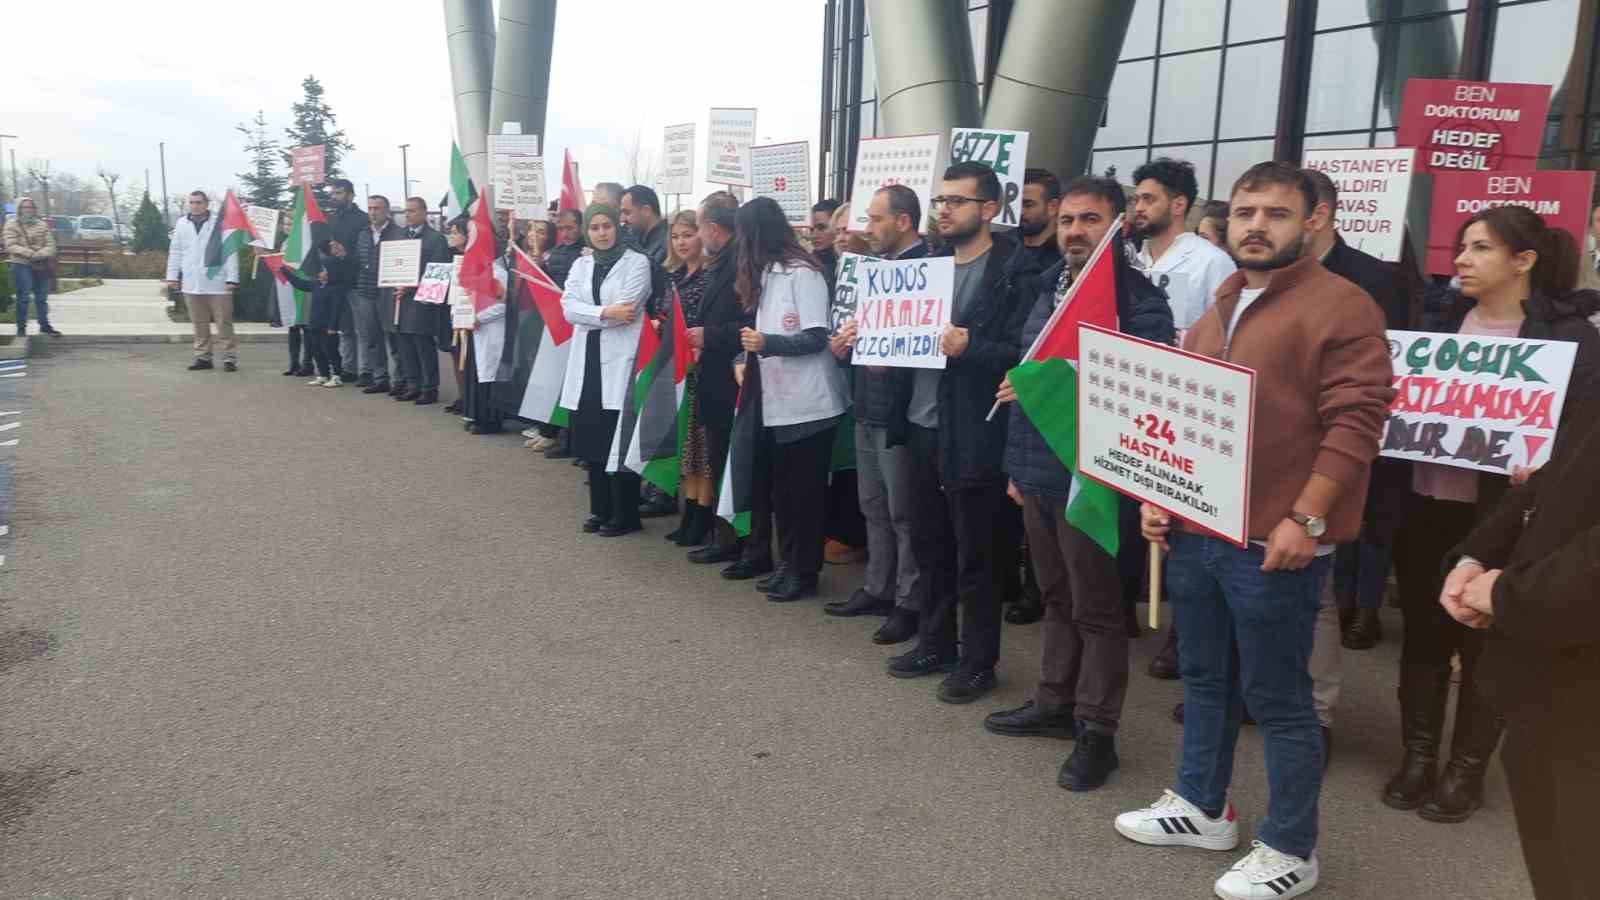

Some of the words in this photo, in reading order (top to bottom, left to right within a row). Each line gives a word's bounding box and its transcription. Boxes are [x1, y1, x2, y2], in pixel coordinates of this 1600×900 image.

[1454, 85, 1497, 103] BEN
[1424, 104, 1521, 122] DOKTORUM
[1431, 129, 1502, 149] HEDEF
[1307, 159, 1409, 173] HASTANEYE
[1430, 150, 1491, 171] DEĞİL
[1487, 175, 1532, 195] BEN
[860, 298, 943, 331] KIRMIZI
[1406, 336, 1549, 384] ÇOCUK
[1133, 413, 1176, 445] +24
[1119, 432, 1195, 475] HASTANE
[1093, 455, 1131, 480] HİZMET
[1108, 447, 1143, 469] HEDEF
[1144, 462, 1205, 497] ALINARAK
